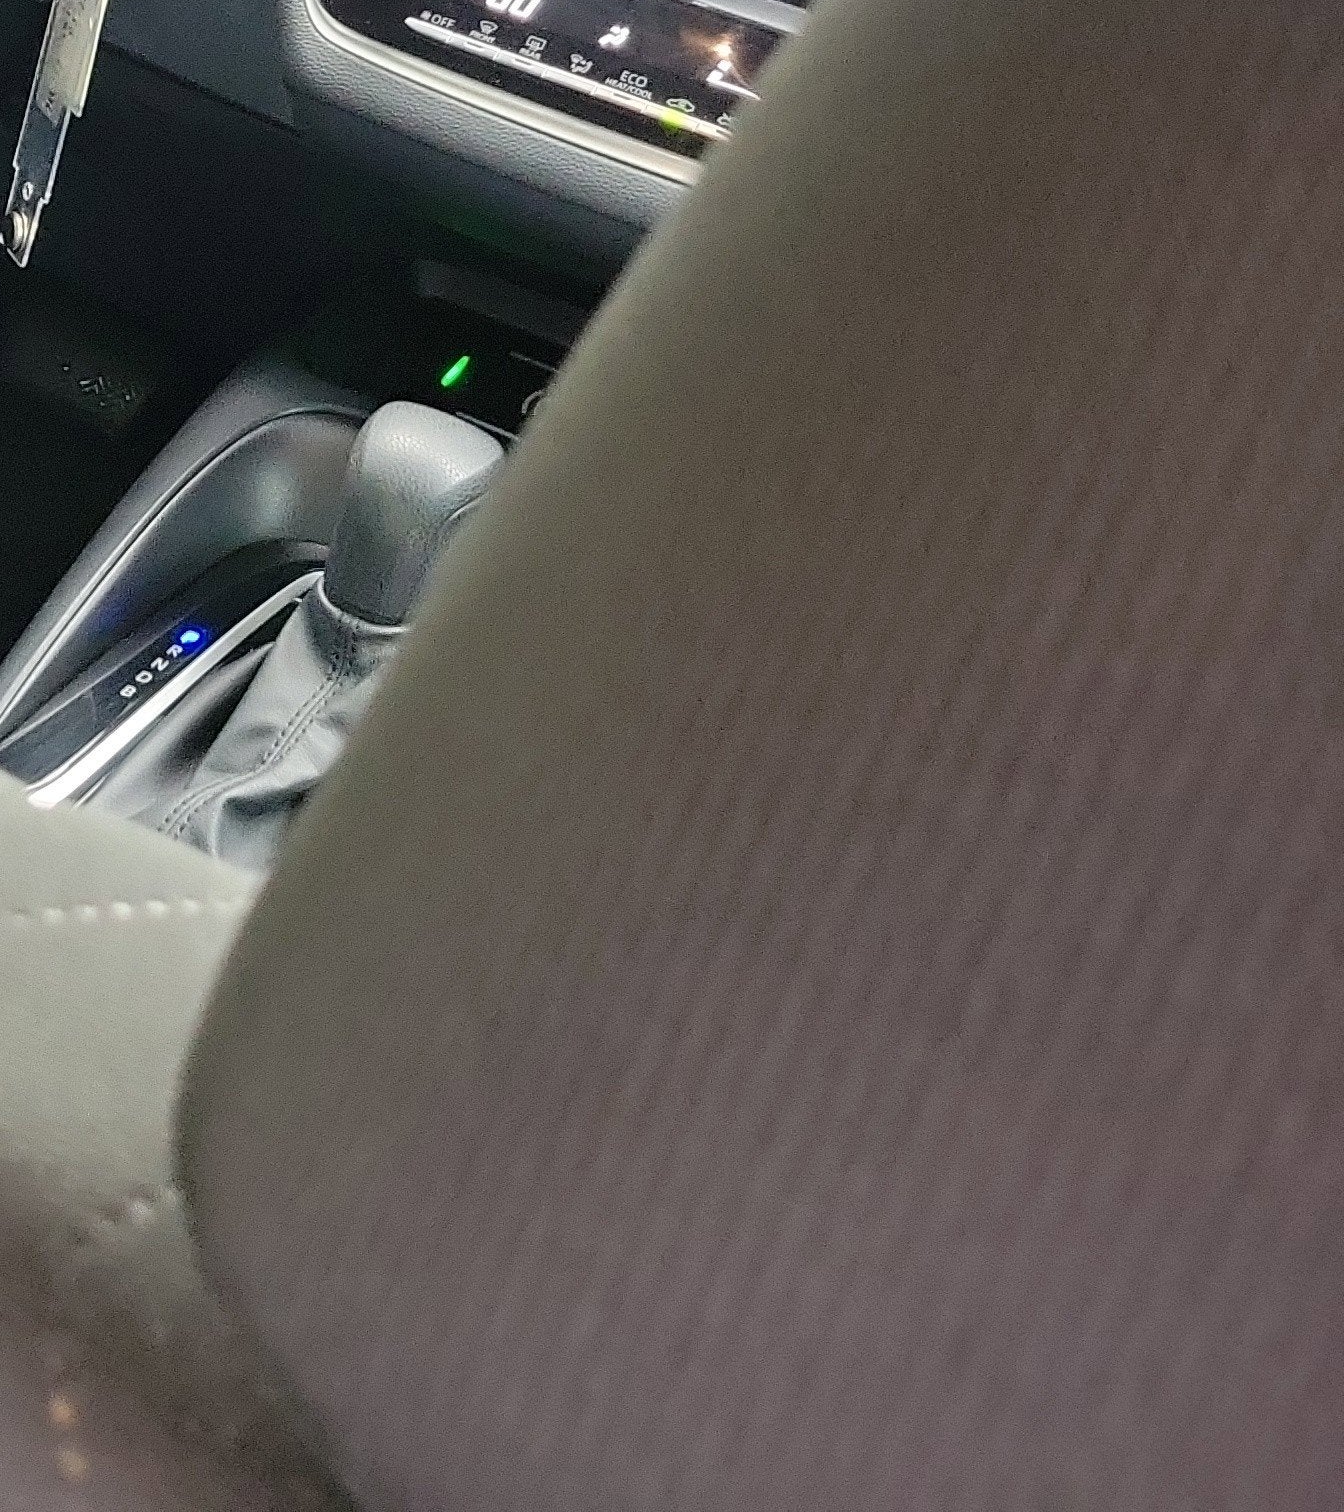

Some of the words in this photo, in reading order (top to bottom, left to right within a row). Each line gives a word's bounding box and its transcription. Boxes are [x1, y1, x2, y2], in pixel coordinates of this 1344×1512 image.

[431, 12, 457, 29] OFF
[468, 29, 496, 44] FRONT
[518, 47, 542, 61] REAR
[619, 69, 648, 88] ECO
[604, 76, 653, 100] HEAT/COOL
